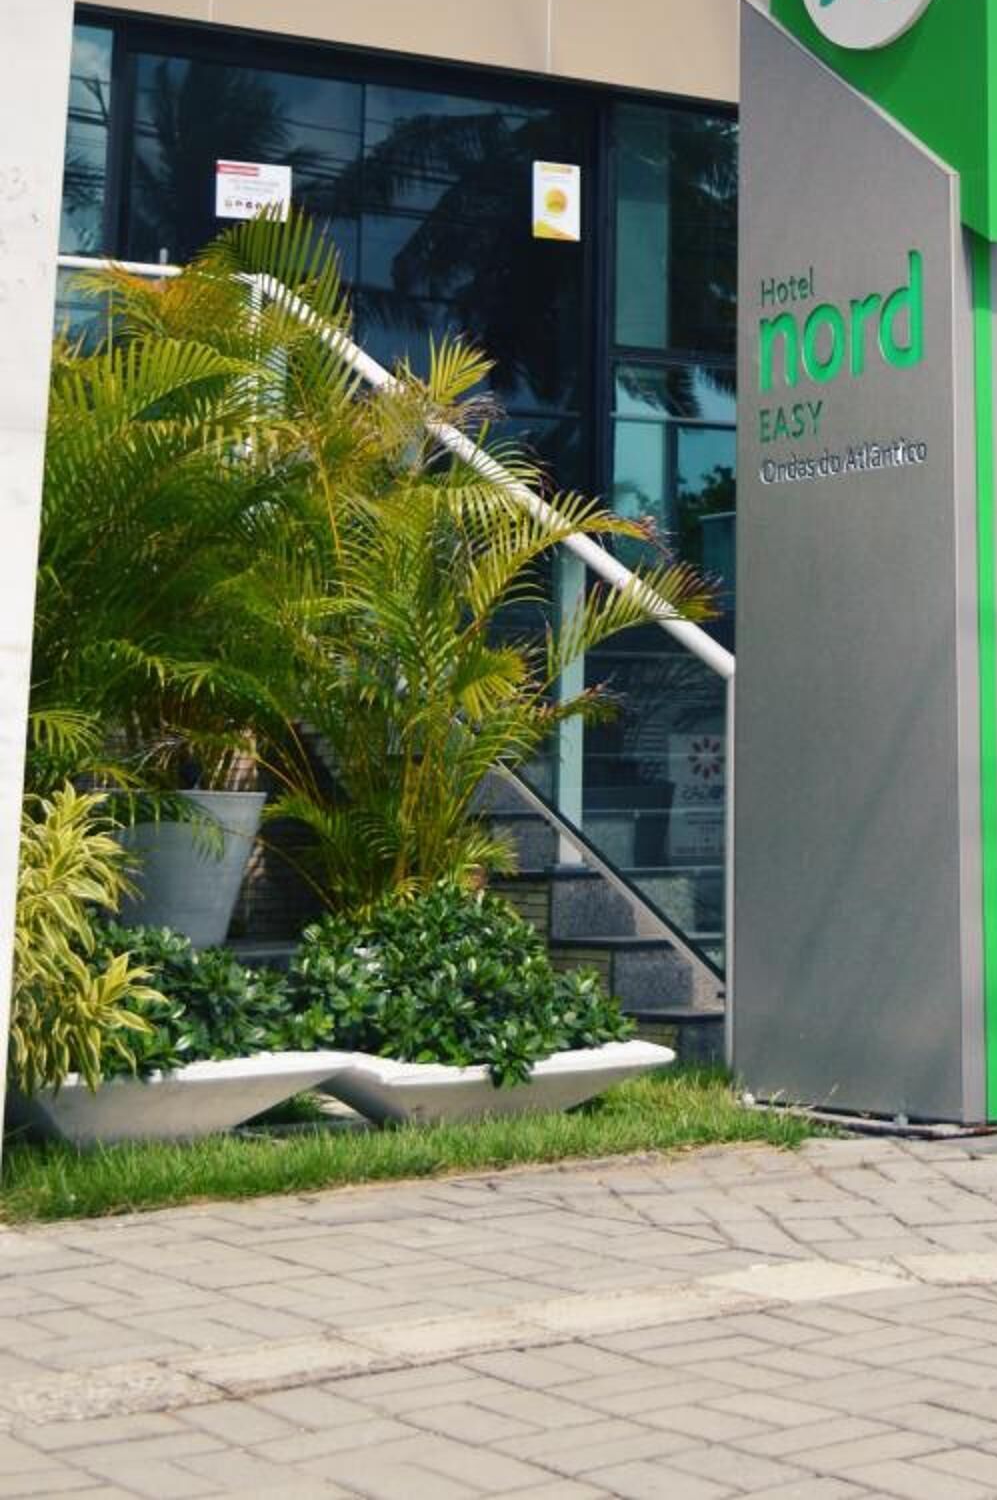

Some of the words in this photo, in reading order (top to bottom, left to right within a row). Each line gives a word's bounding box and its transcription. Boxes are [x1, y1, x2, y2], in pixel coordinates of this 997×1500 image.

[760, 266, 814, 307] Hotel
[758, 249, 923, 392] nord
[758, 400, 823, 443] EASY
[760, 452, 816, 485] Ondas
[817, 447, 842, 477] do
[843, 437, 928, 474] Atlântico
